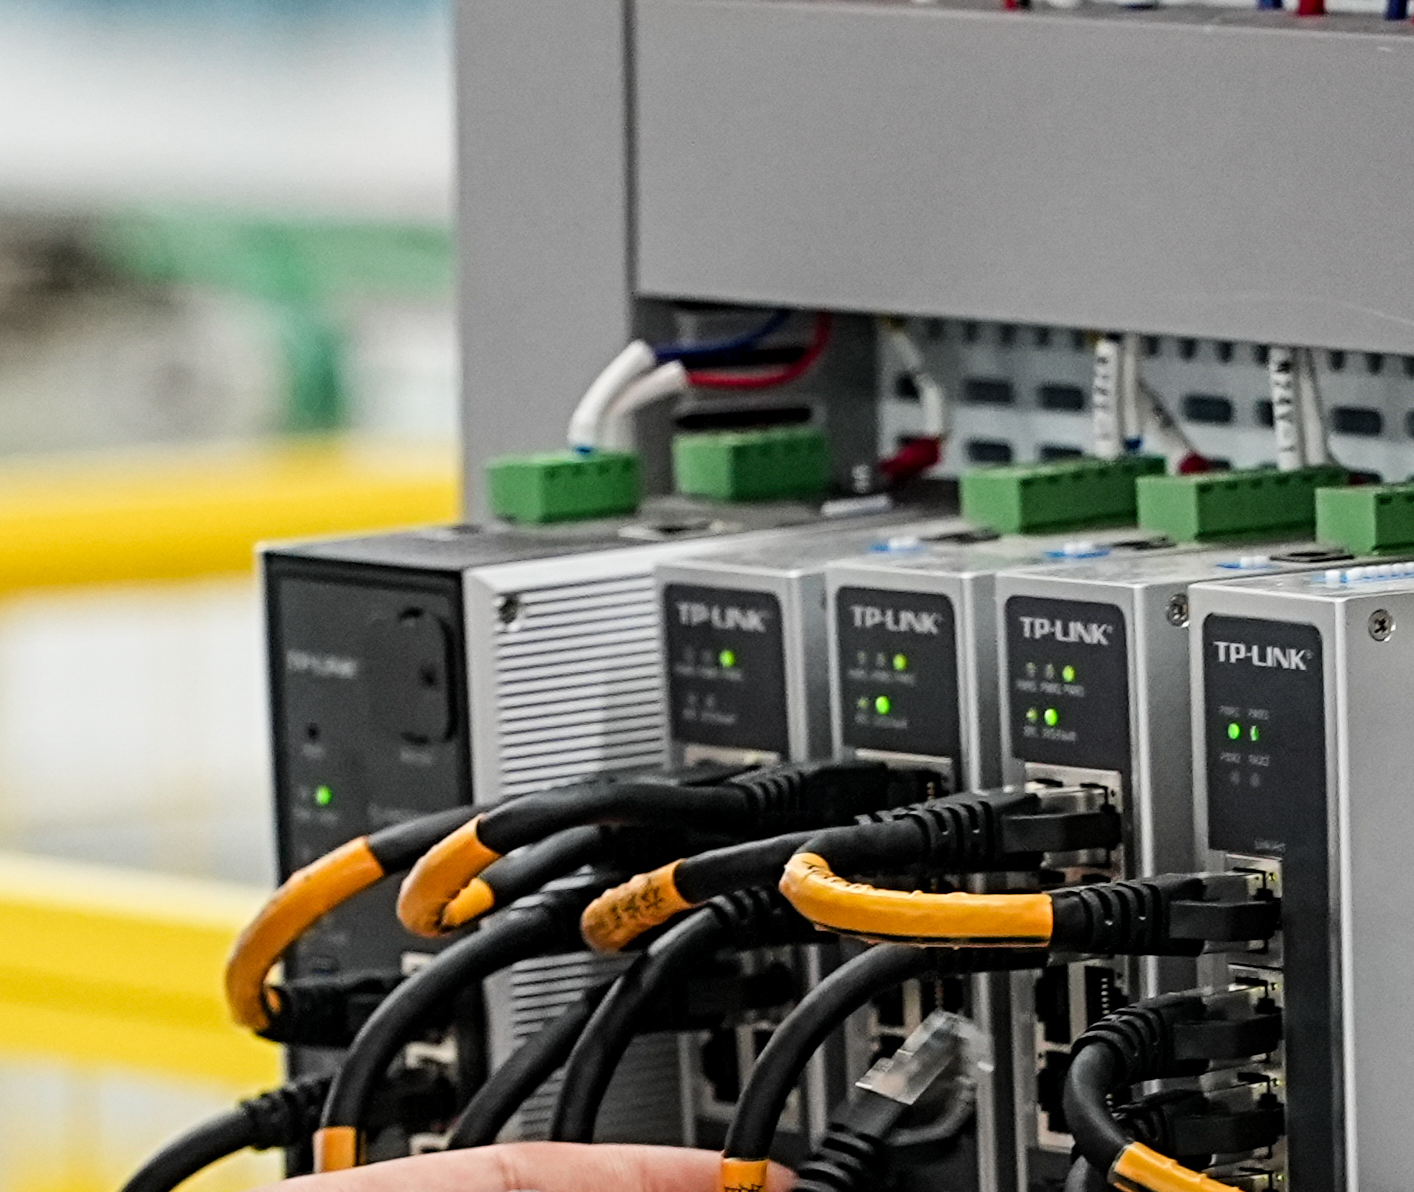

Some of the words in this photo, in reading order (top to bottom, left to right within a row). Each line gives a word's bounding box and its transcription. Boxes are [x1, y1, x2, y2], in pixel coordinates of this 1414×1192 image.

[849, 604, 939, 635] TP-LINK
[1018, 616, 1109, 646] TP-LINK
[1213, 641, 1307, 671] TP-LINK
